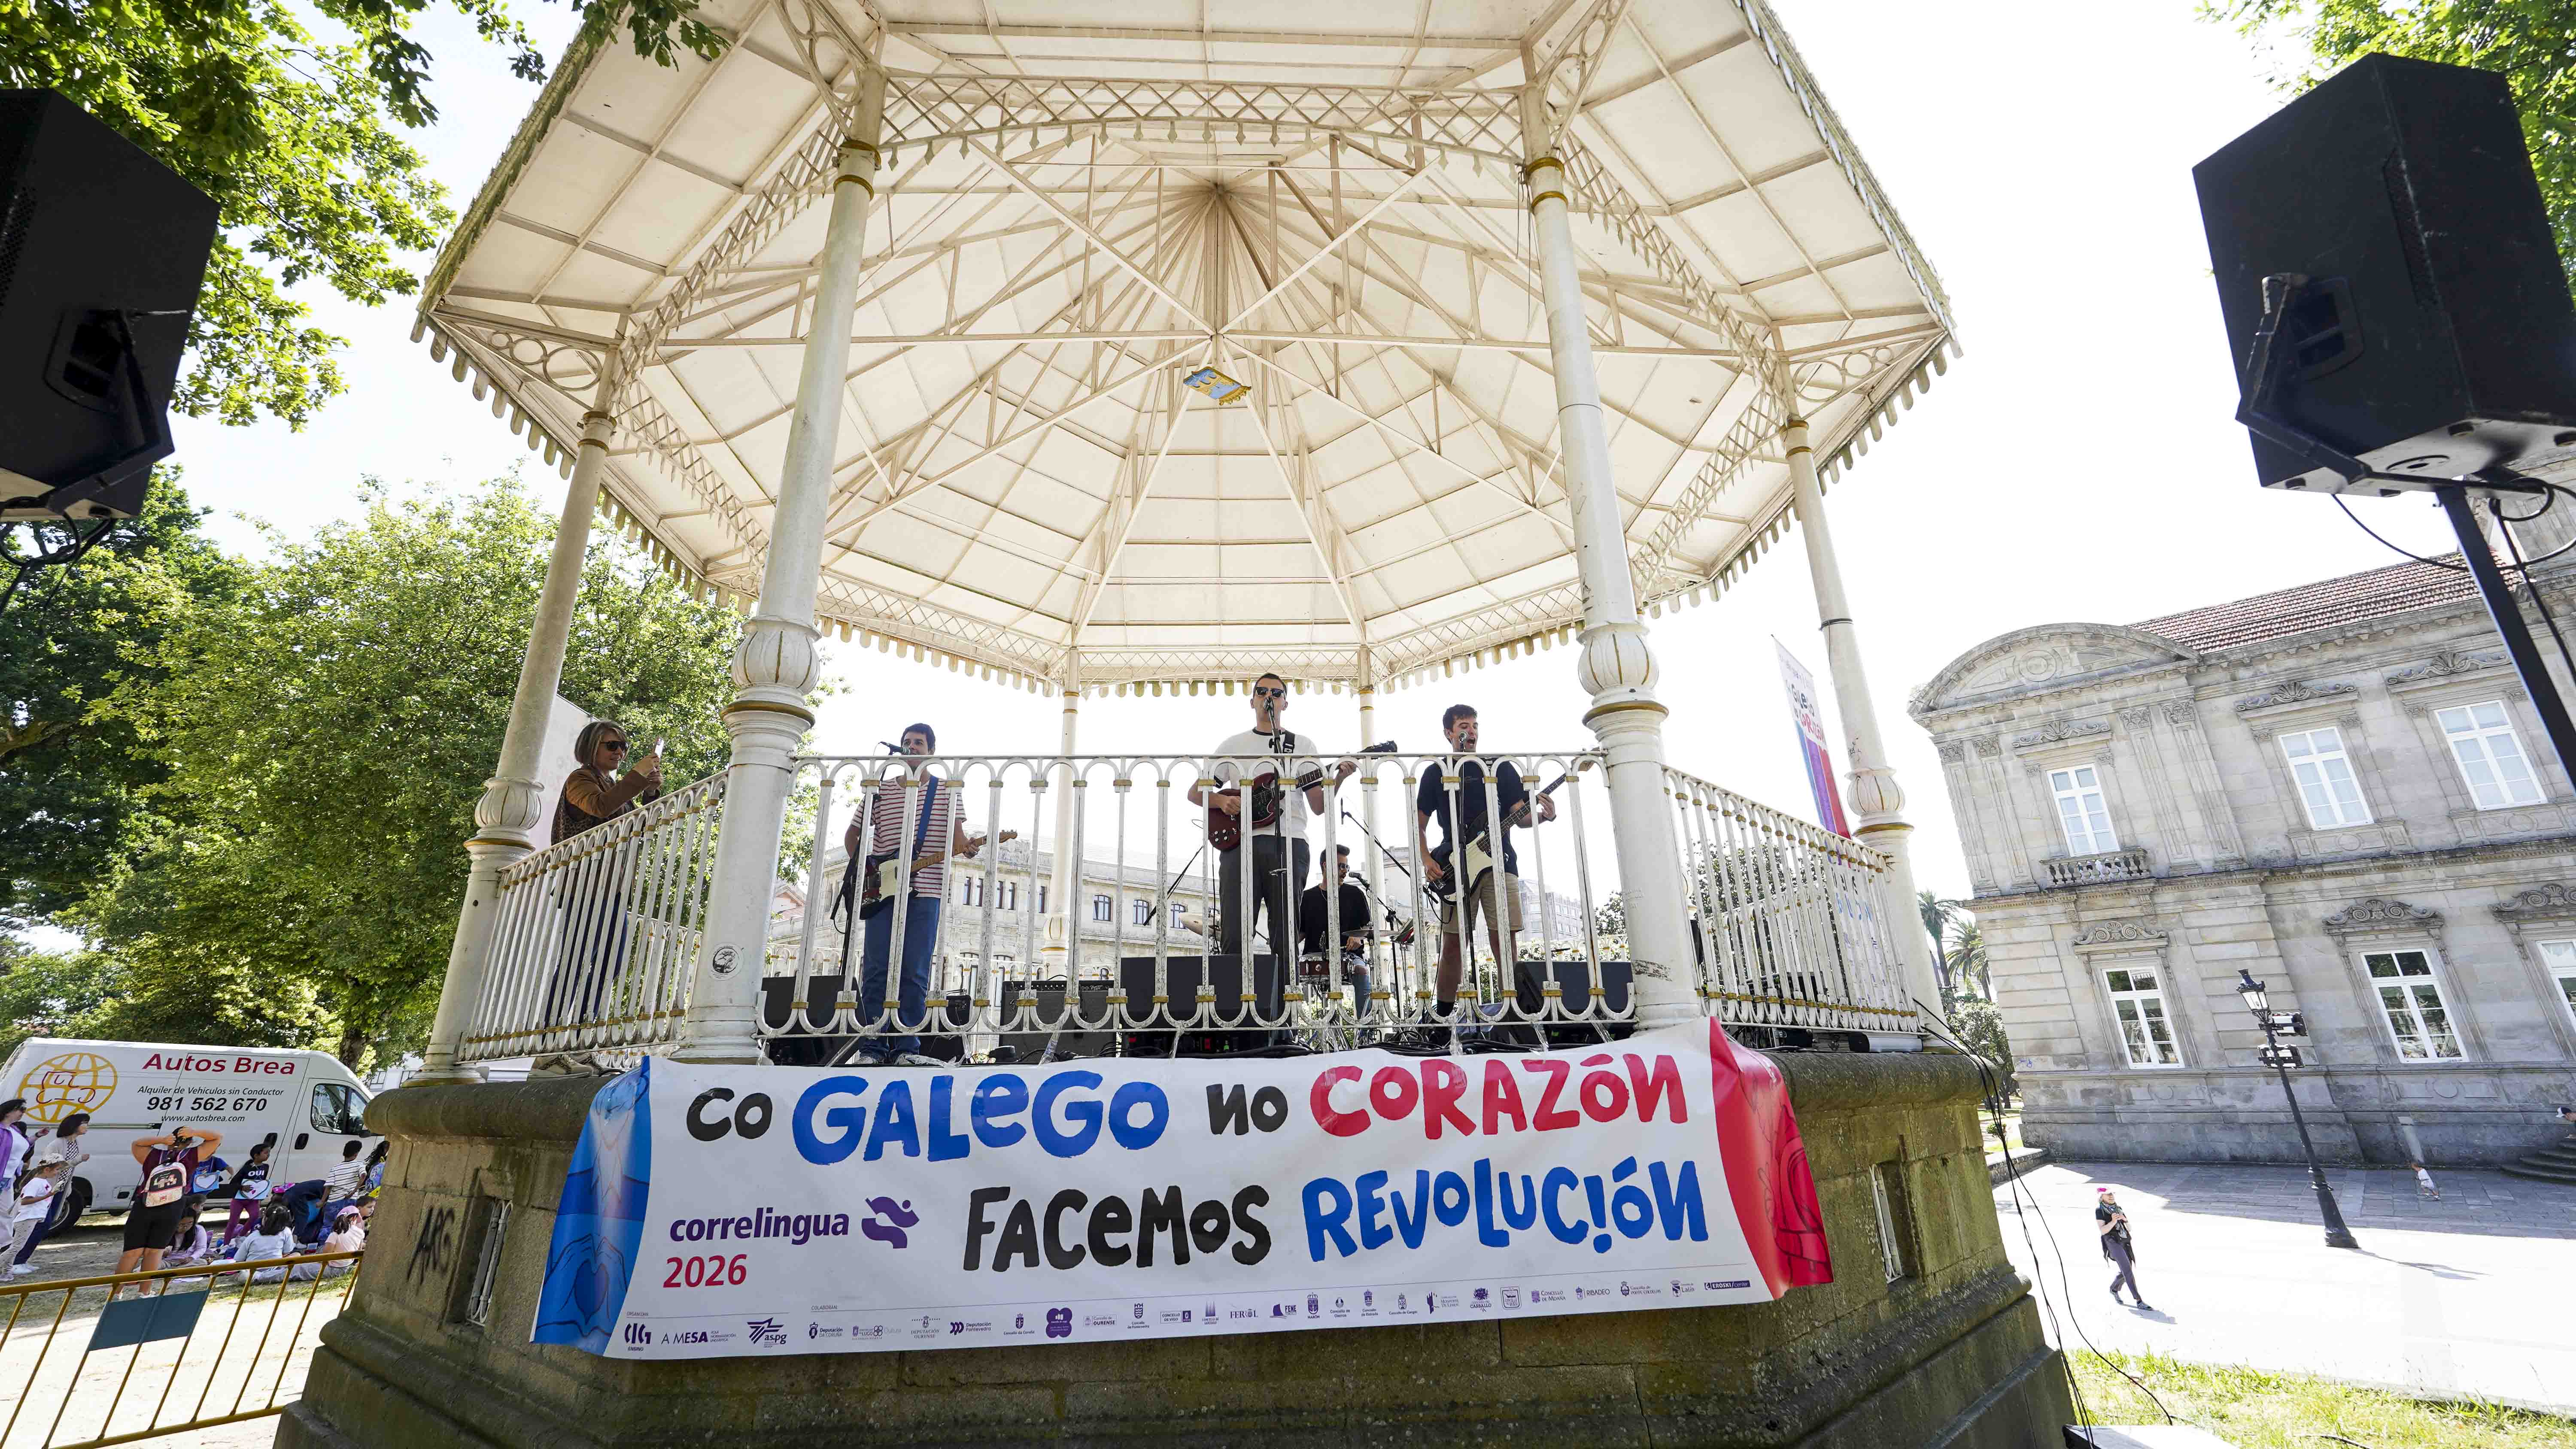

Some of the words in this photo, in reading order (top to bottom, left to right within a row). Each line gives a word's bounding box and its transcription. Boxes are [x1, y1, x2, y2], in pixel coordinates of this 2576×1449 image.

[142, 1054, 227, 1072] Autos
[233, 1057, 295, 1074] Brea
[137, 1086, 172, 1094] Alquiler
[1310, 1055, 1688, 1140] CORAZÓN
[147, 1097, 184, 1110] 981
[191, 1097, 227, 1111] 562
[233, 1098, 267, 1111] 670
[670, 1207, 849, 1246] correlingua
[664, 1255, 746, 1288] 2026
[661, 1333, 670, 1344] A
[673, 1331, 708, 1344] MESA
